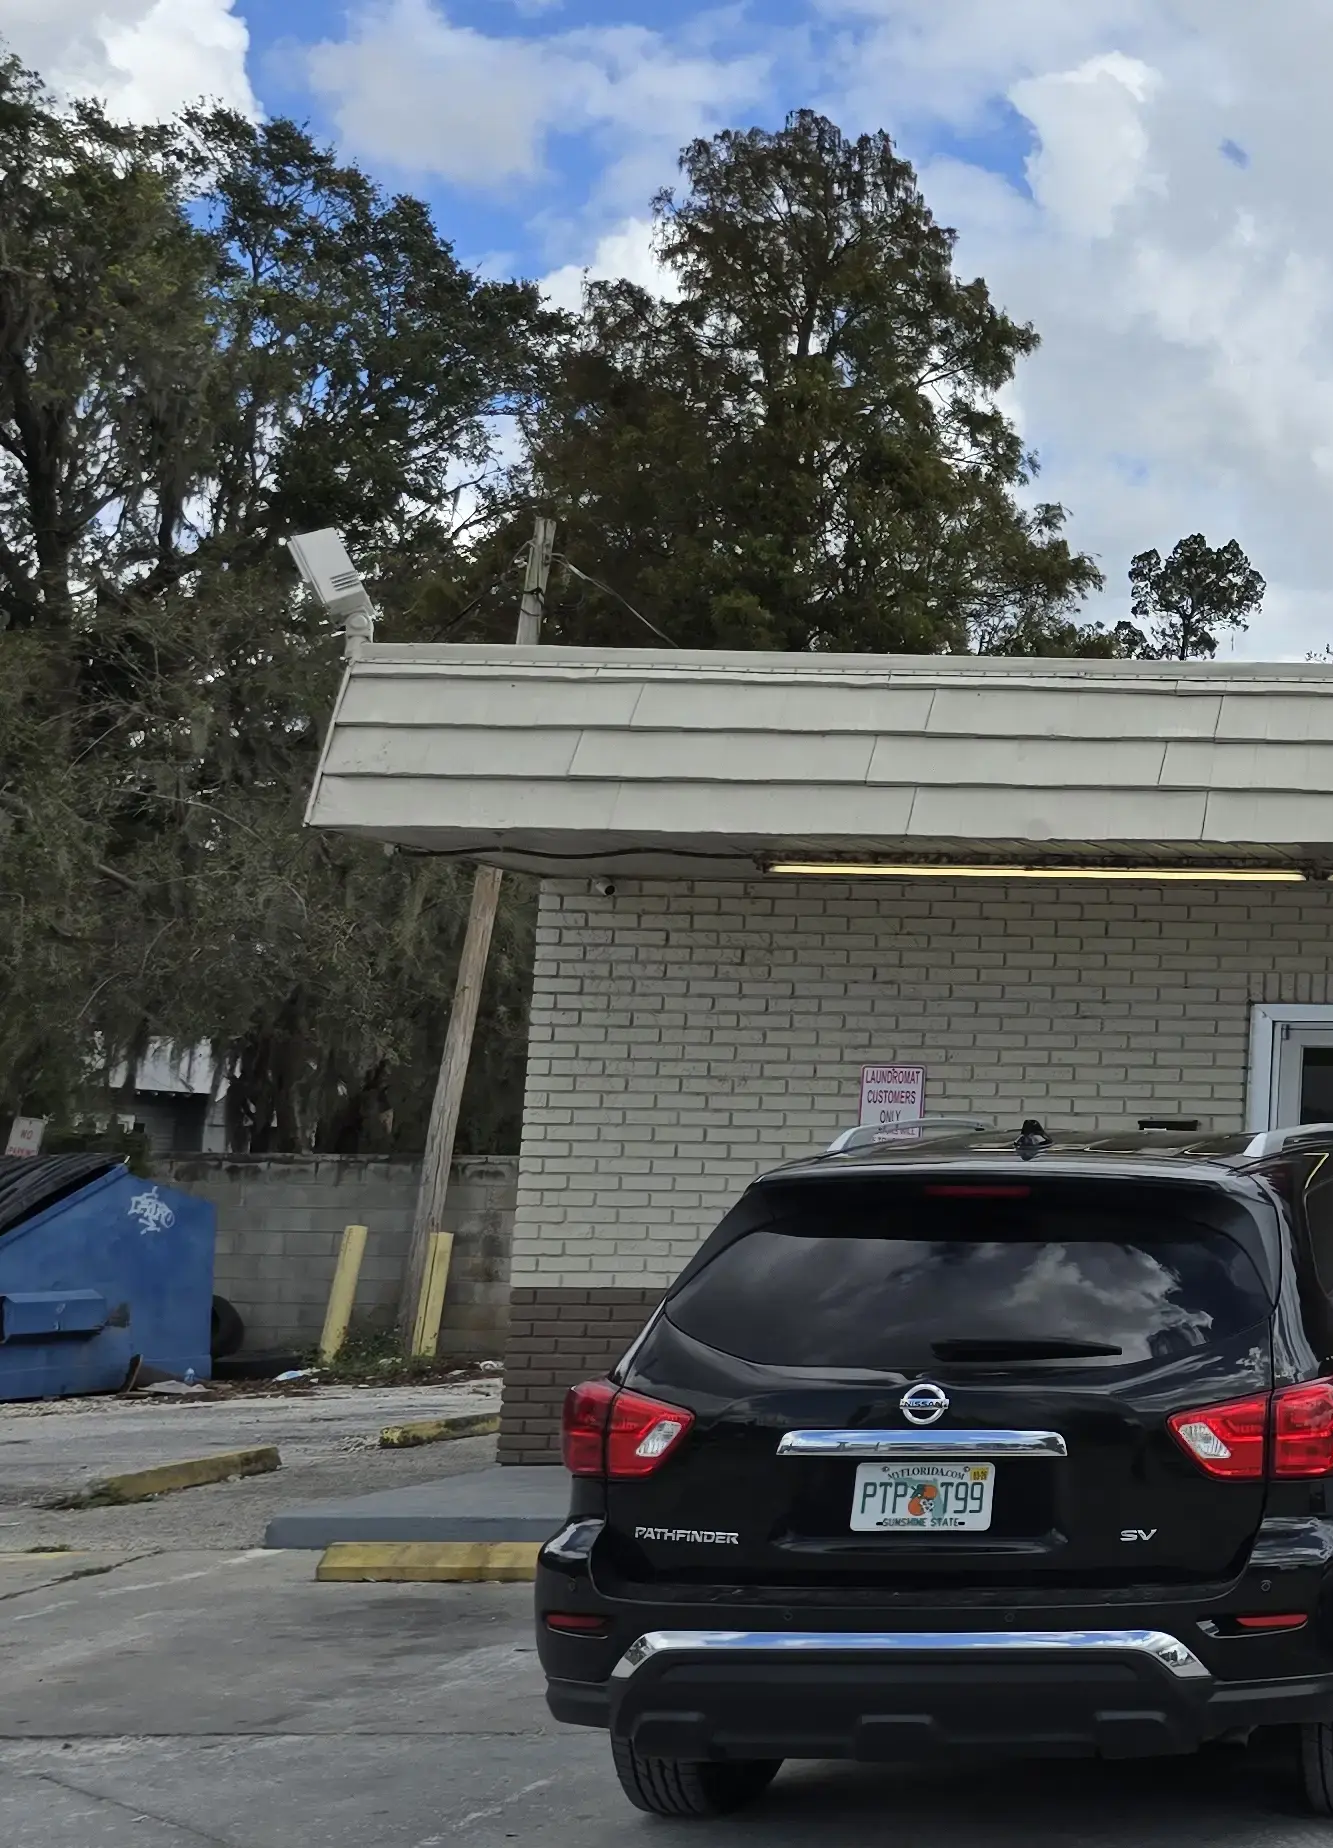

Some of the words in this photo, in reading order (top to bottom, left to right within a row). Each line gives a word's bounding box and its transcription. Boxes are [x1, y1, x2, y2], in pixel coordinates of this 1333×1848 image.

[865, 1070, 920, 1085] LAUNDROMAT
[867, 1089, 917, 1105] CUSTOMERS
[880, 1109, 902, 1123] ONLY
[20, 1129, 34, 1140] NO
[903, 1399, 944, 1409] NISSAN
[887, 1466, 965, 1481] MYFLORIDA.COM
[860, 1482, 908, 1514] PTP
[940, 1482, 985, 1514] T99
[882, 1517, 927, 1527] SUNSHINE
[930, 1517, 959, 1527] STATE
[634, 1526, 739, 1545] PATHFINDER
[1120, 1529, 1158, 1541] SV
